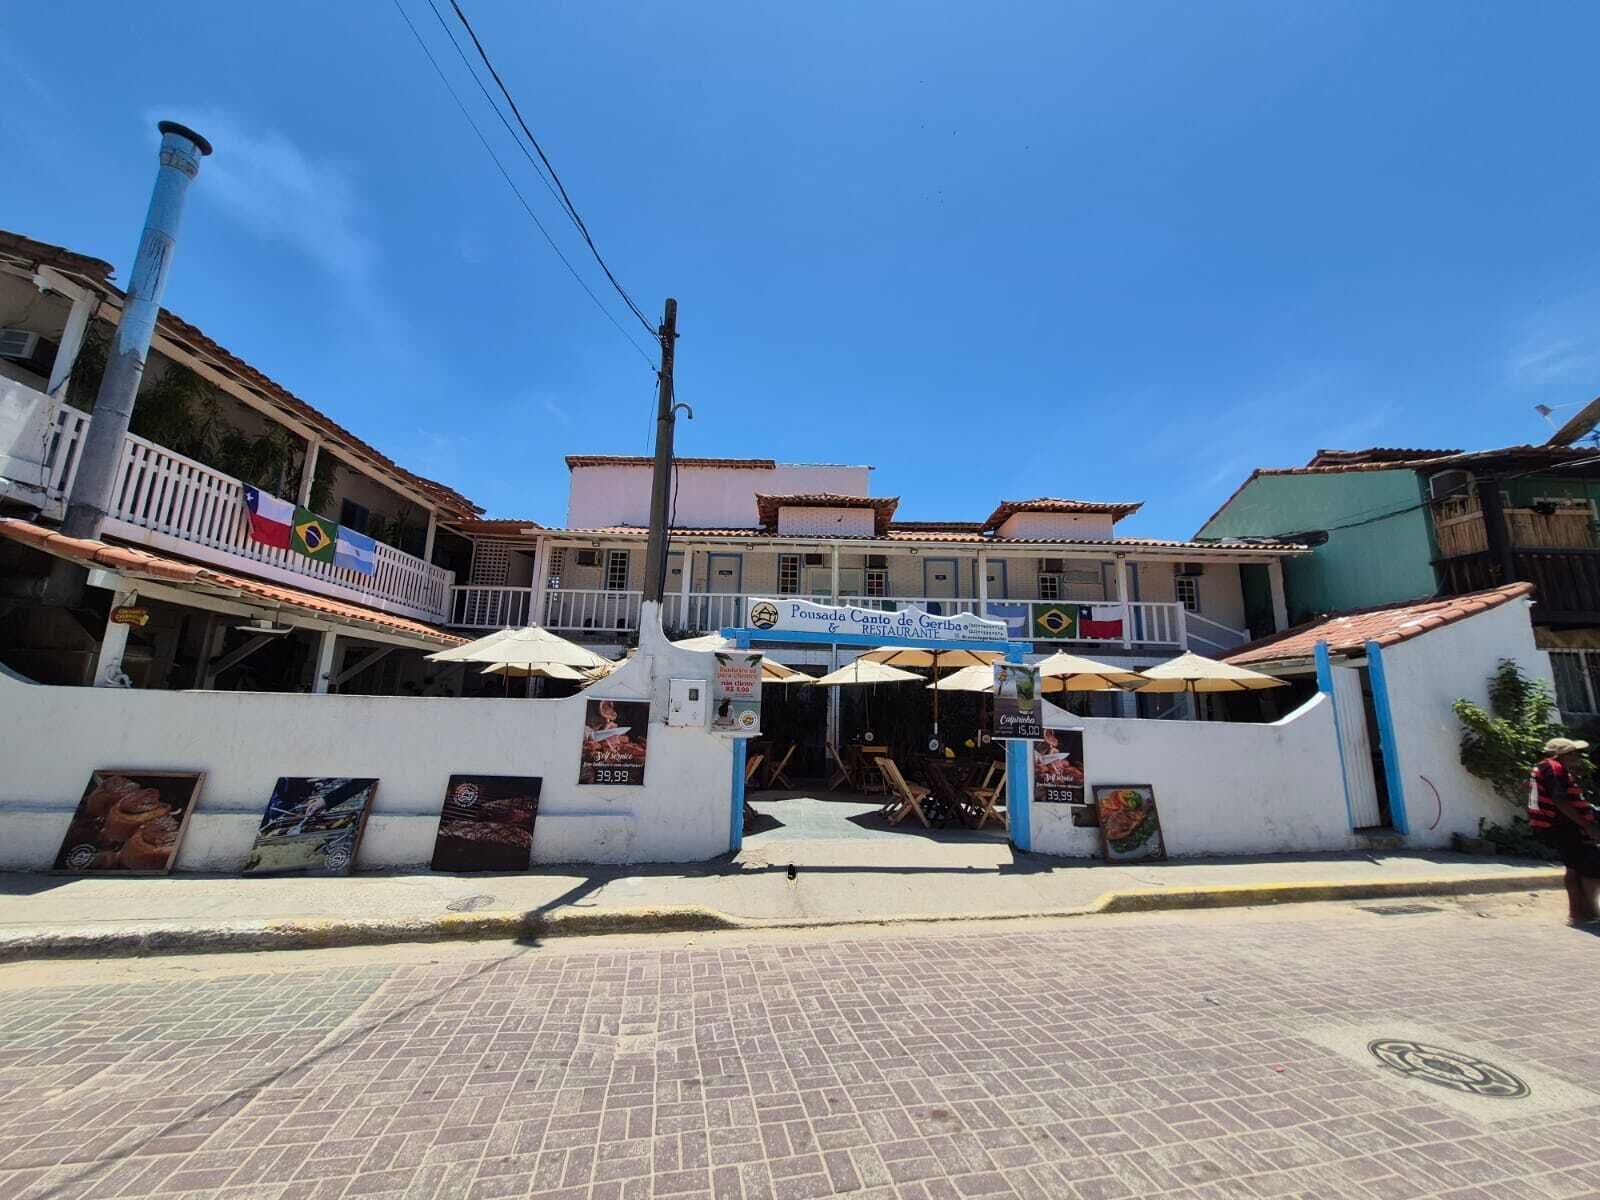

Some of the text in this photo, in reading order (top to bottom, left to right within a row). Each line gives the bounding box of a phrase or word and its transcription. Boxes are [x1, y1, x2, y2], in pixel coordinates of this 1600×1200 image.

[791, 604, 846, 621] Pousada
[850, 609, 890, 625] Canto
[897, 612, 913, 626] de
[828, 622, 939, 639] & RESTAURANTE
[1018, 725, 1040, 736] 15,00
[596, 770, 629, 782] 39,99
[1047, 789, 1073, 801] 39,99
